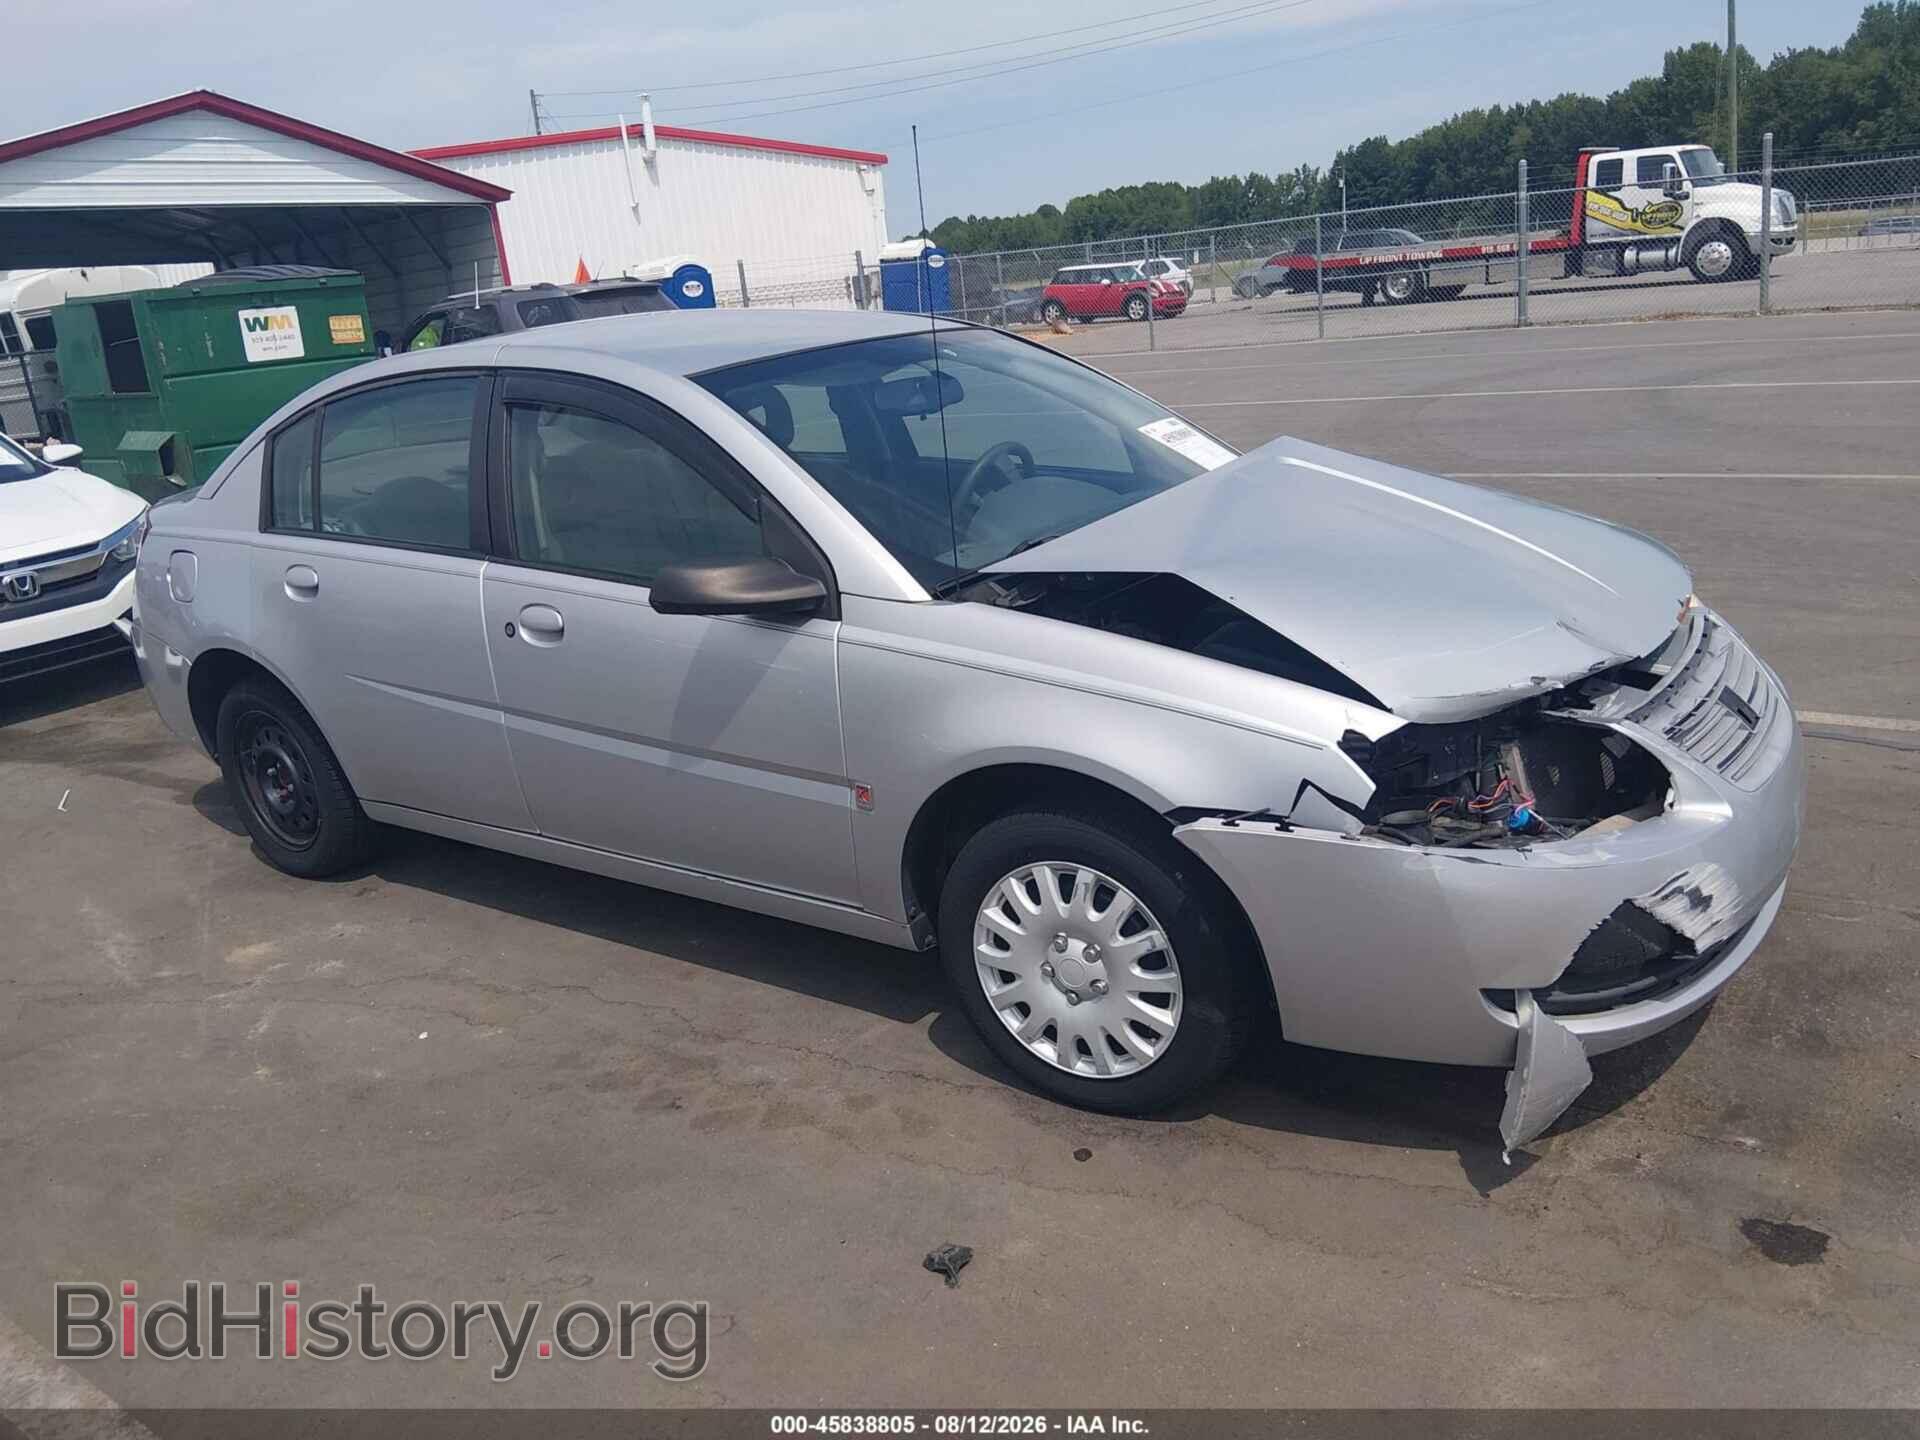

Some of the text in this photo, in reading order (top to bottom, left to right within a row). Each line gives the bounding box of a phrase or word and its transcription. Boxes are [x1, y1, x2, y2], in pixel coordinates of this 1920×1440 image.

[1373, 253, 1404, 263] FRONT
[1405, 250, 1443, 261] TOWING
[243, 315, 294, 332] WM
